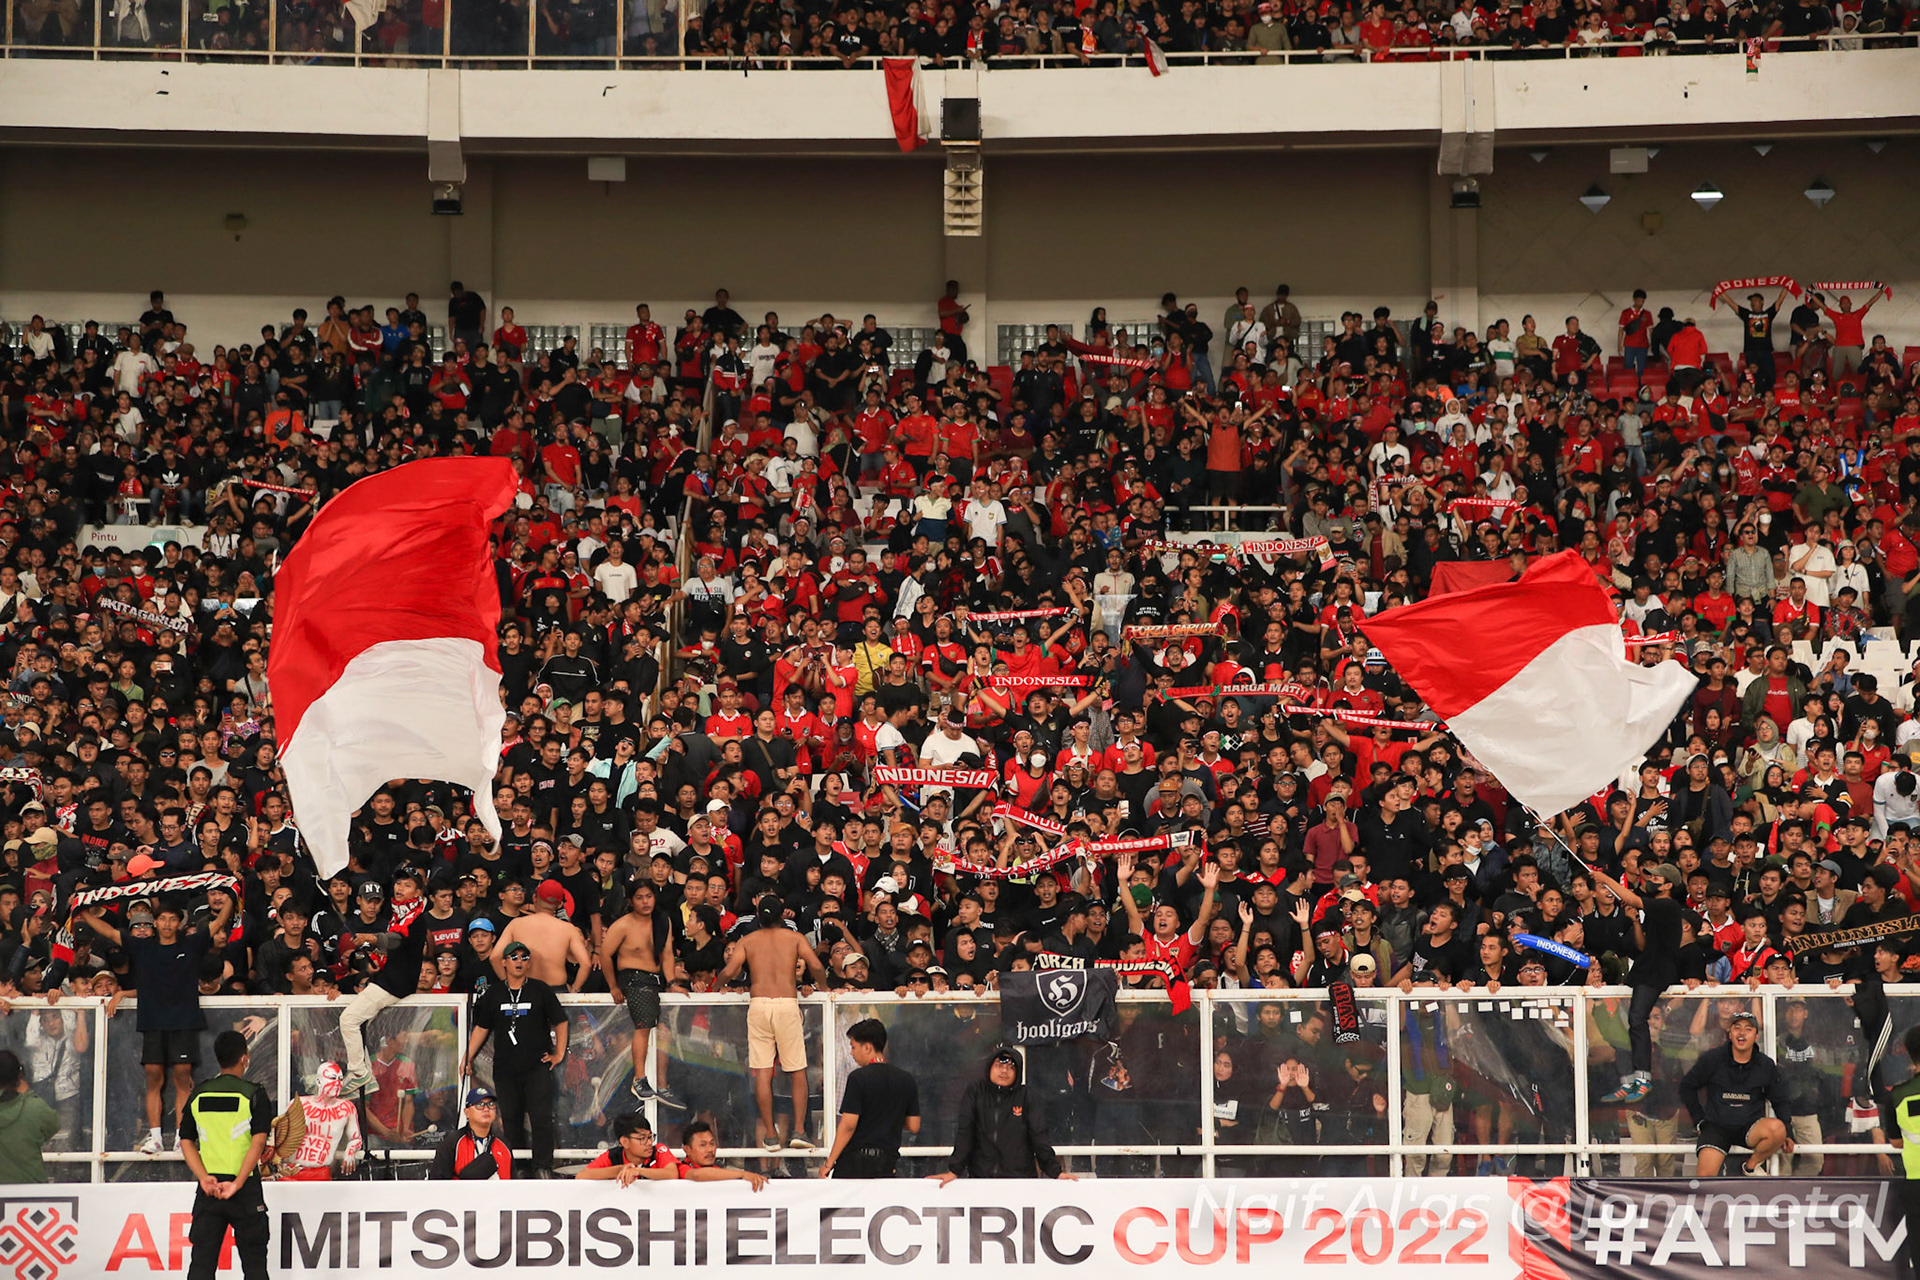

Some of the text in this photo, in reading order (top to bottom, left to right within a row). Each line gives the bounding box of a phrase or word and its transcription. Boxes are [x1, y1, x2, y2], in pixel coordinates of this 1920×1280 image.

[91, 532, 118, 542] Pintu
[1145, 539, 1221, 550] NDONESIA
[1253, 537, 1322, 553] INDONESIA
[972, 609, 1060, 620] INDONESIA
[1128, 622, 1218, 636] FORZA GARUDA
[995, 675, 1081, 686] INDONESIA
[876, 768, 989, 785] INDONESIA
[1091, 837, 1164, 851] DONESIA
[76, 872, 238, 905] INDONESIA
[365, 884, 381, 894] NY
[1791, 914, 1920, 955] INDONESIA
[1536, 939, 1581, 963] INDONESIA
[1016, 1018, 1100, 1042] hooligans
[300, 1136, 331, 1156] EVER
[280, 1208, 708, 1270] MITSUBISHI
[726, 1205, 1095, 1266] ELECTRIC
[1113, 1206, 1284, 1266] CUP
[1303, 1207, 1489, 1265] 2022
